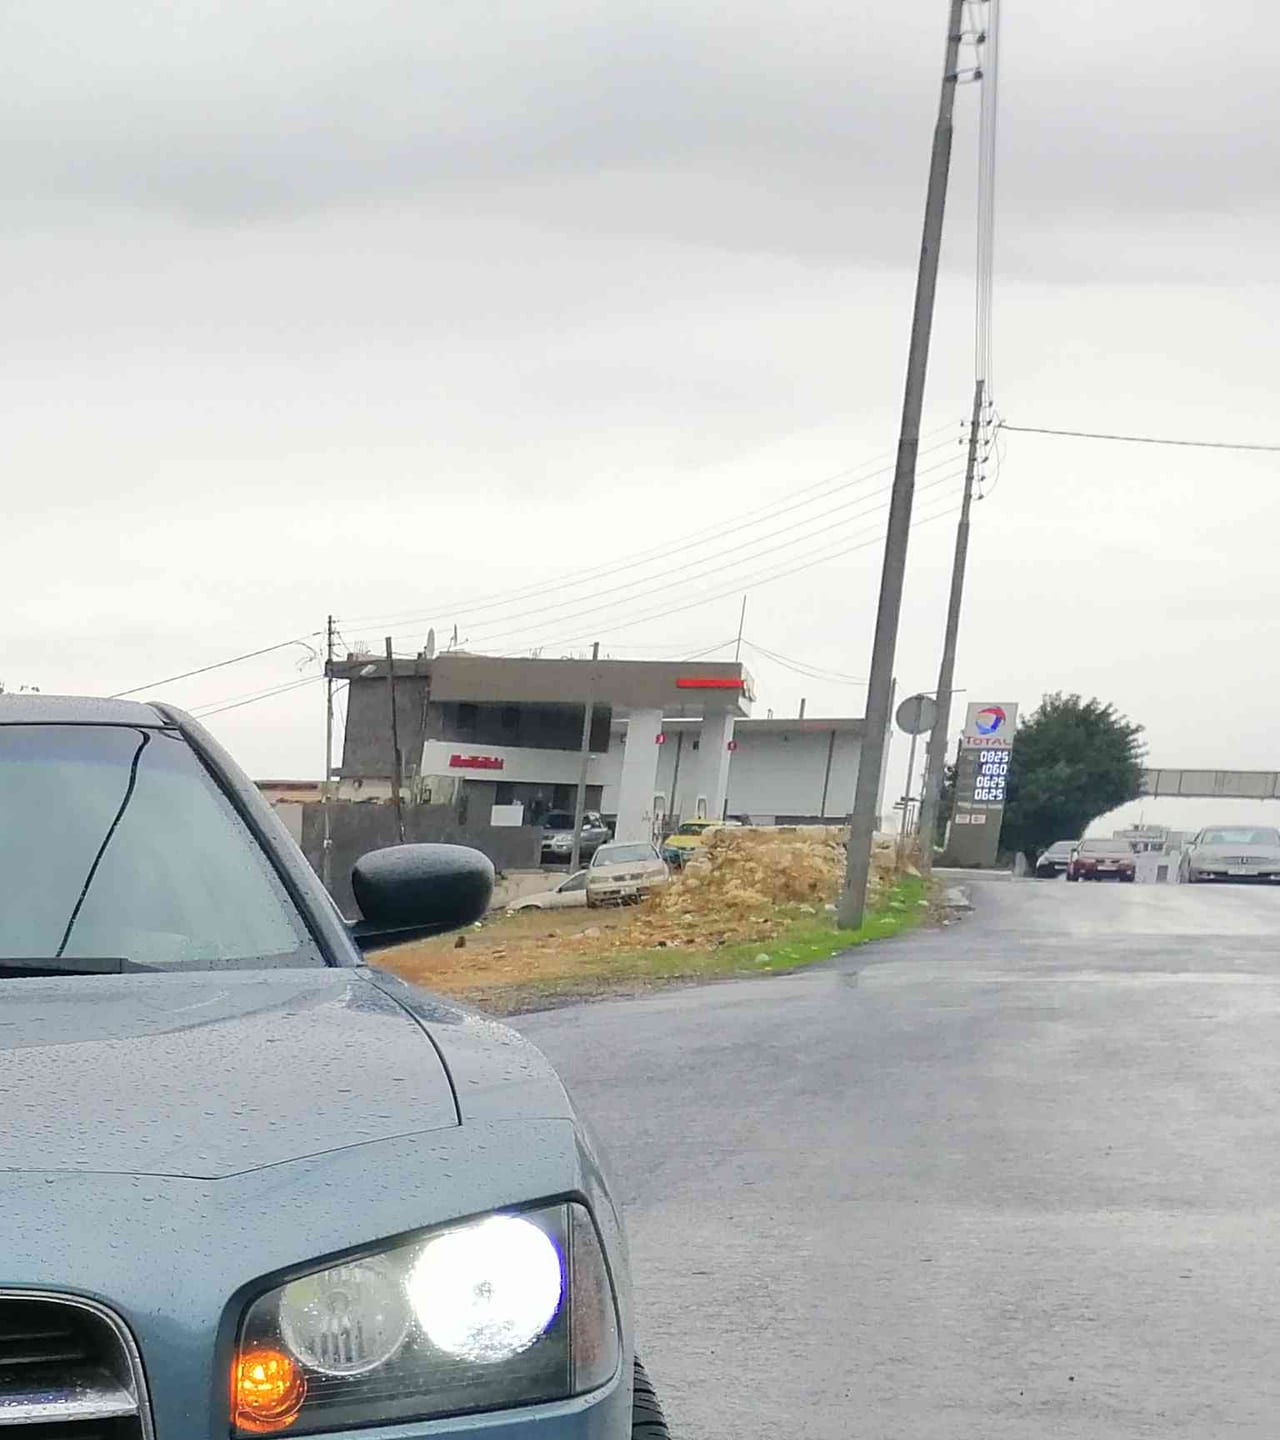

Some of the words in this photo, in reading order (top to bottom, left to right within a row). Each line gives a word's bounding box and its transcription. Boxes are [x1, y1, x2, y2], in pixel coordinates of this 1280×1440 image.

[966, 736, 1011, 746] TOTAL
[980, 751, 1009, 763] 0825
[982, 763, 1007, 775] 1060
[976, 775, 1005, 788] 0625
[974, 788, 1003, 800] 0625
